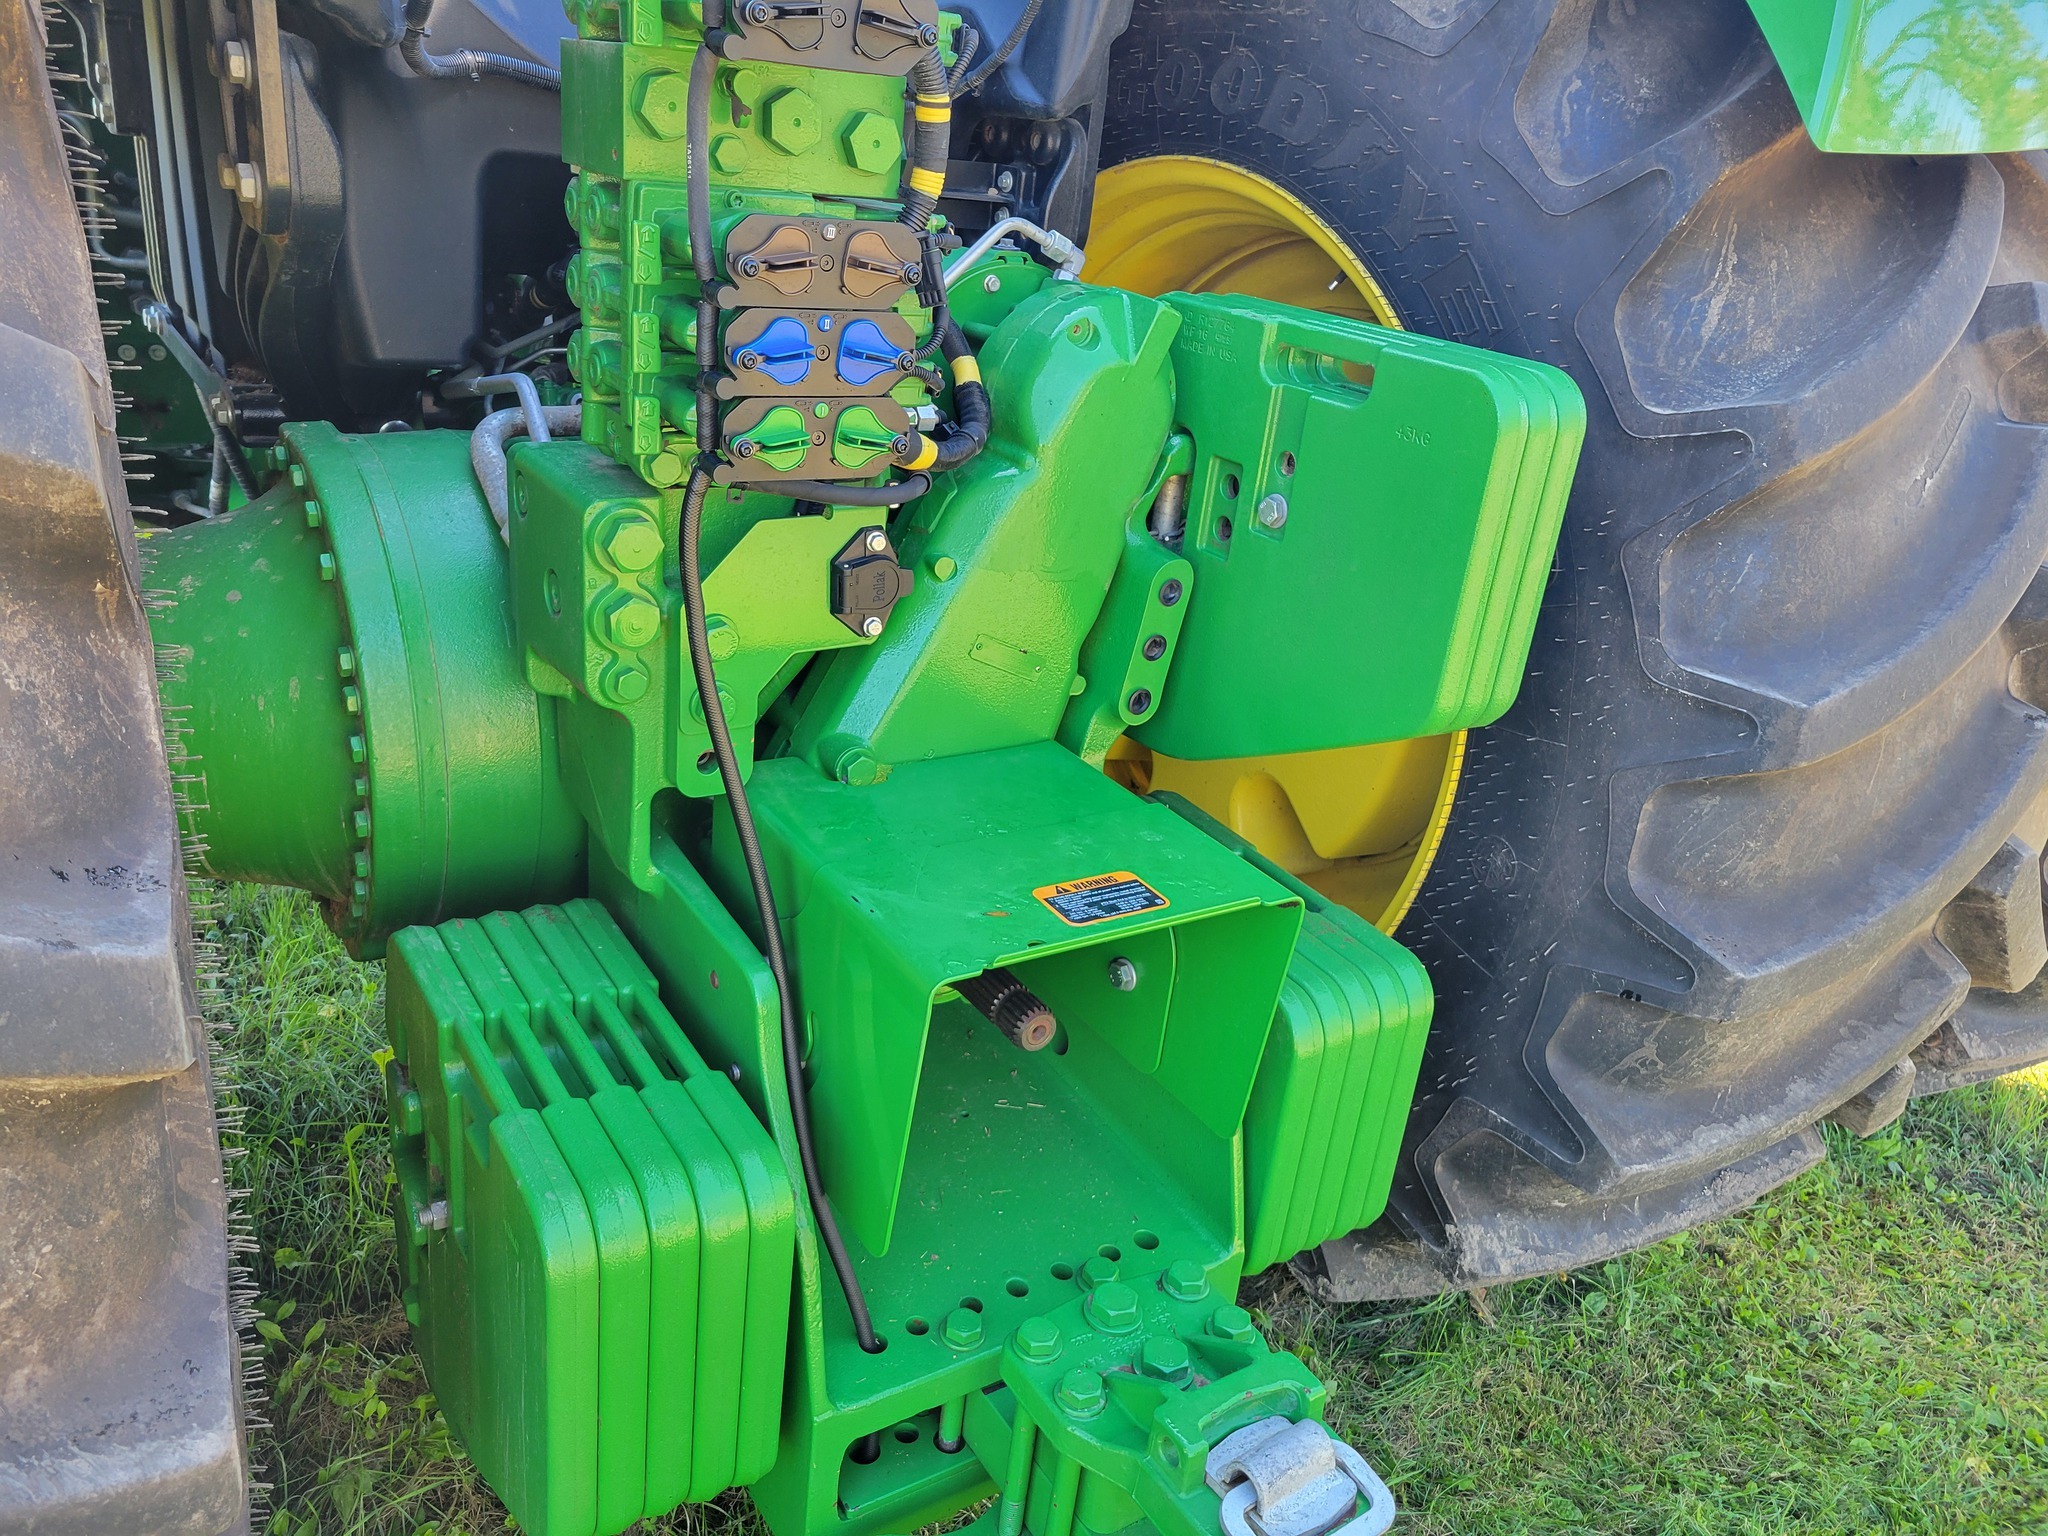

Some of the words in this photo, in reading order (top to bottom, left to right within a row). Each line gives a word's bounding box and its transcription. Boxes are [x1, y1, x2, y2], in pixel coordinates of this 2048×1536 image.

[1180, 338, 1204, 354] MADE
[1206, 345, 1217, 357] IN
[1219, 349, 1238, 363] USA
[872, 570, 886, 604] Pollak
[1070, 875, 1119, 891] WARNING
